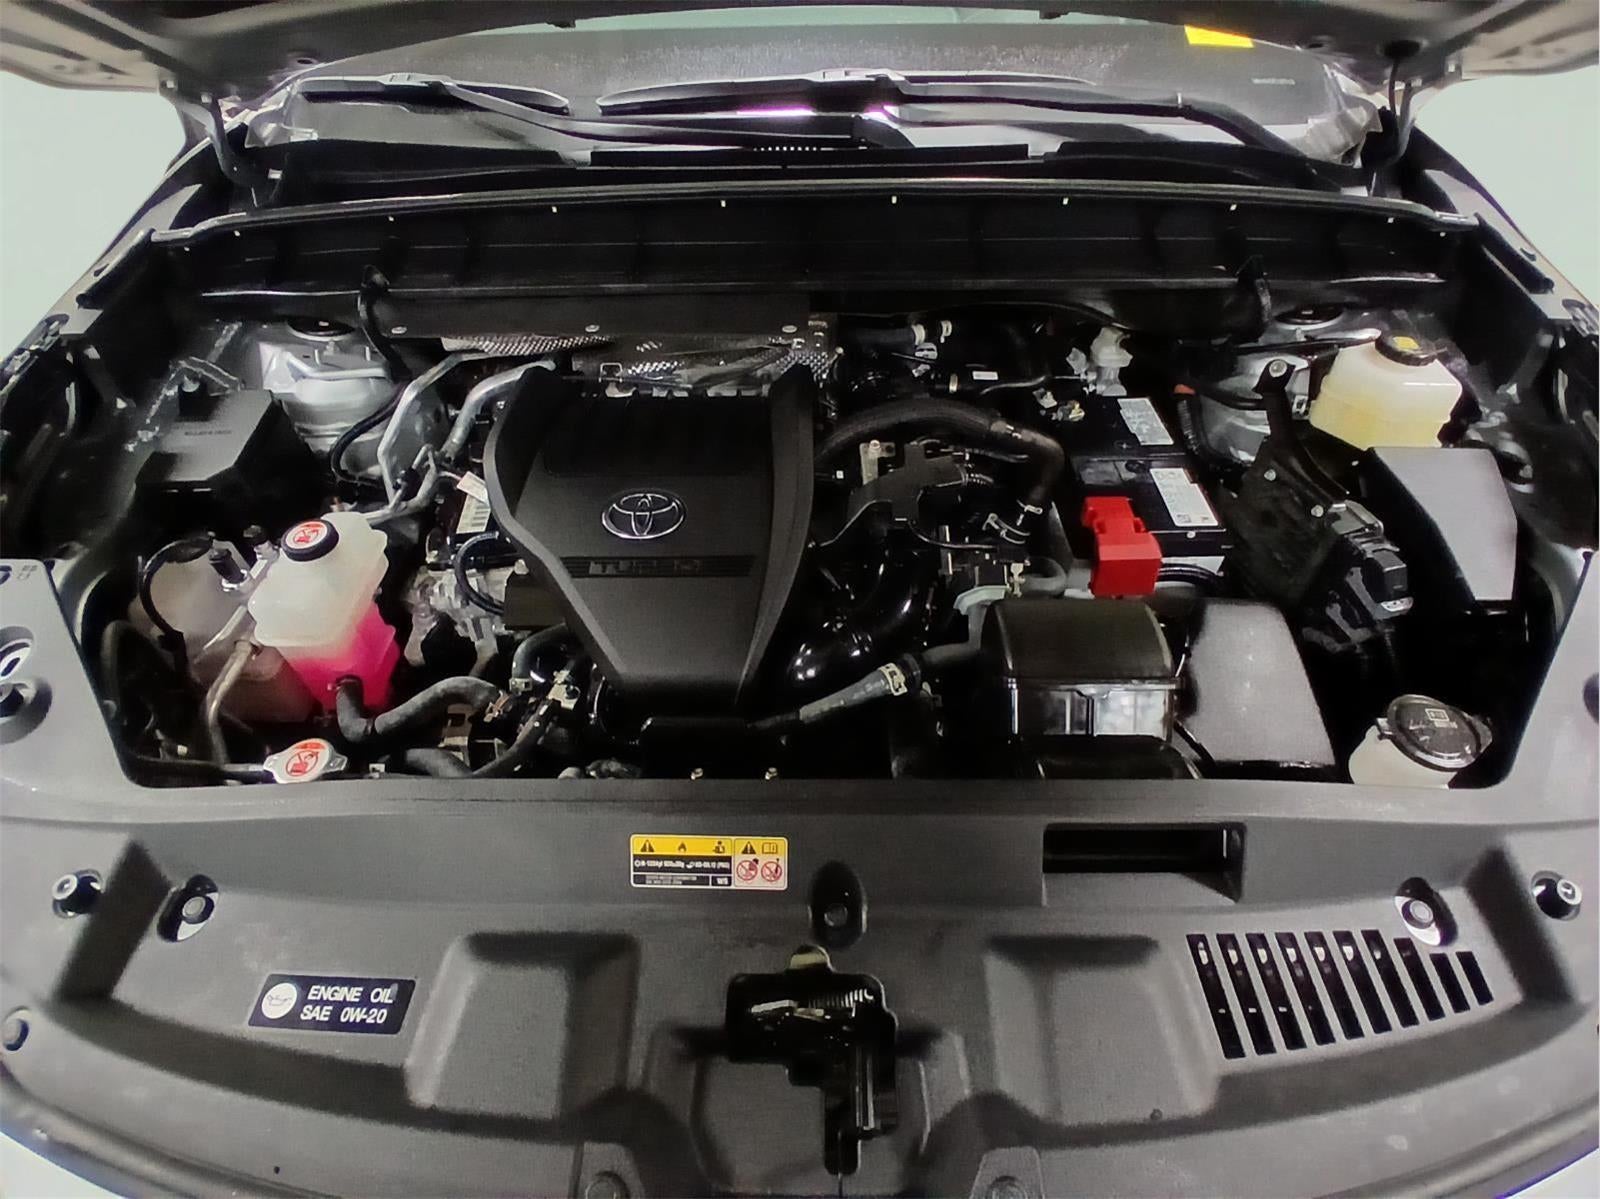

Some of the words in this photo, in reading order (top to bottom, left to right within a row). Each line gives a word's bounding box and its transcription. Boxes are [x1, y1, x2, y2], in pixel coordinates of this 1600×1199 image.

[588, 560, 701, 575] TURO
[308, 985, 363, 1002] ENGINE
[370, 988, 395, 1004] OIL
[300, 1005, 333, 1021] SAE
[340, 1008, 387, 1024] 0W-20
